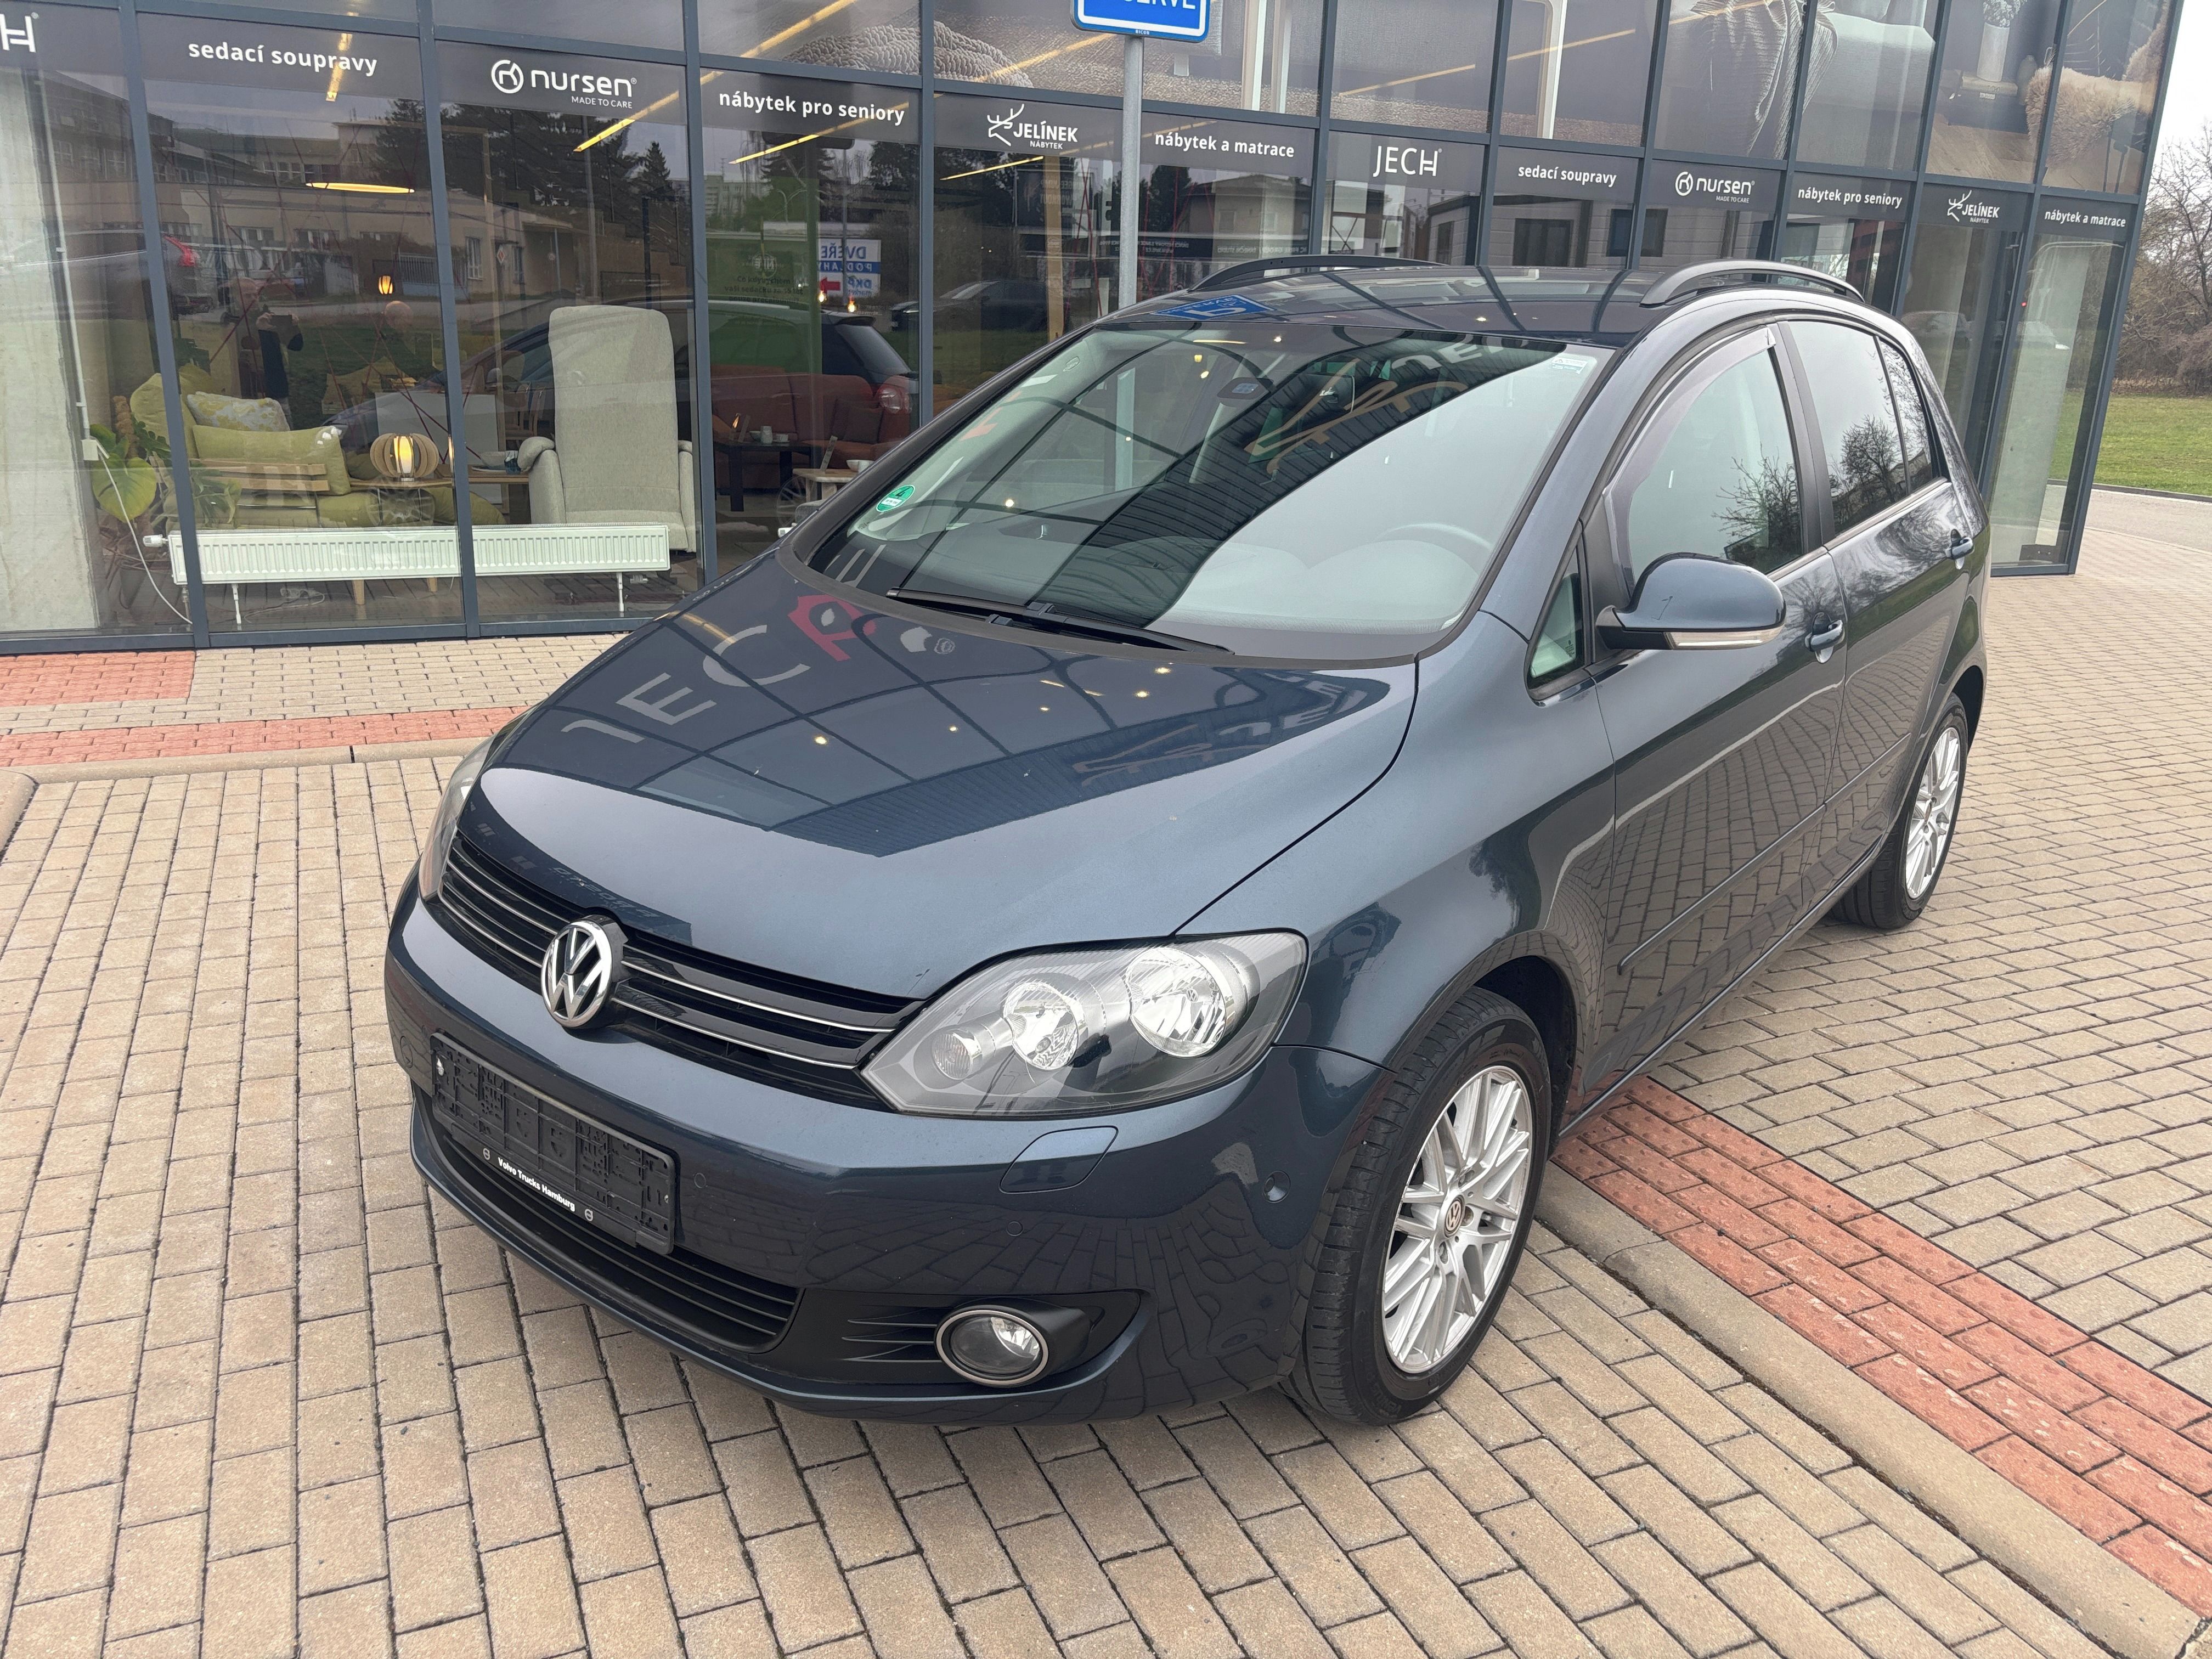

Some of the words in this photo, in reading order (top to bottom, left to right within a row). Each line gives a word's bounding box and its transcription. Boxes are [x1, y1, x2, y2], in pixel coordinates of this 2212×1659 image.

[188, 42, 264, 63] sedací
[272, 50, 377, 77] soupravy
[571, 95, 597, 105] MADE
[598, 98, 609, 106] TO
[611, 100, 633, 109] CARE
[719, 91, 796, 114] nábytek
[803, 101, 833, 118] pro
[838, 104, 905, 127] seniory
[1013, 120, 1079, 143] JELÍNEK
[1030, 139, 1063, 150] NÁBYTEK
[1155, 132, 1217, 151] nábytek
[1221, 141, 1230, 151] a
[1234, 142, 1295, 158] matrace
[1373, 145, 1438, 177] JECH
[1518, 165, 1559, 180] sedací
[1560, 170, 1617, 188] soupravy
[1798, 187, 1842, 203] nábytek
[1843, 193, 1862, 206] pro
[1864, 194, 1903, 209] seniory
[1962, 201, 2000, 219] JELÍNEK
[2045, 209, 2081, 224] nábytek
[2083, 215, 2089, 224] a
[2090, 216, 2126, 228] matrace
[498, 1156, 517, 1176] Volvo
[517, 1169, 541, 1190] Trucks
[541, 1184, 575, 1212] Hamburg
